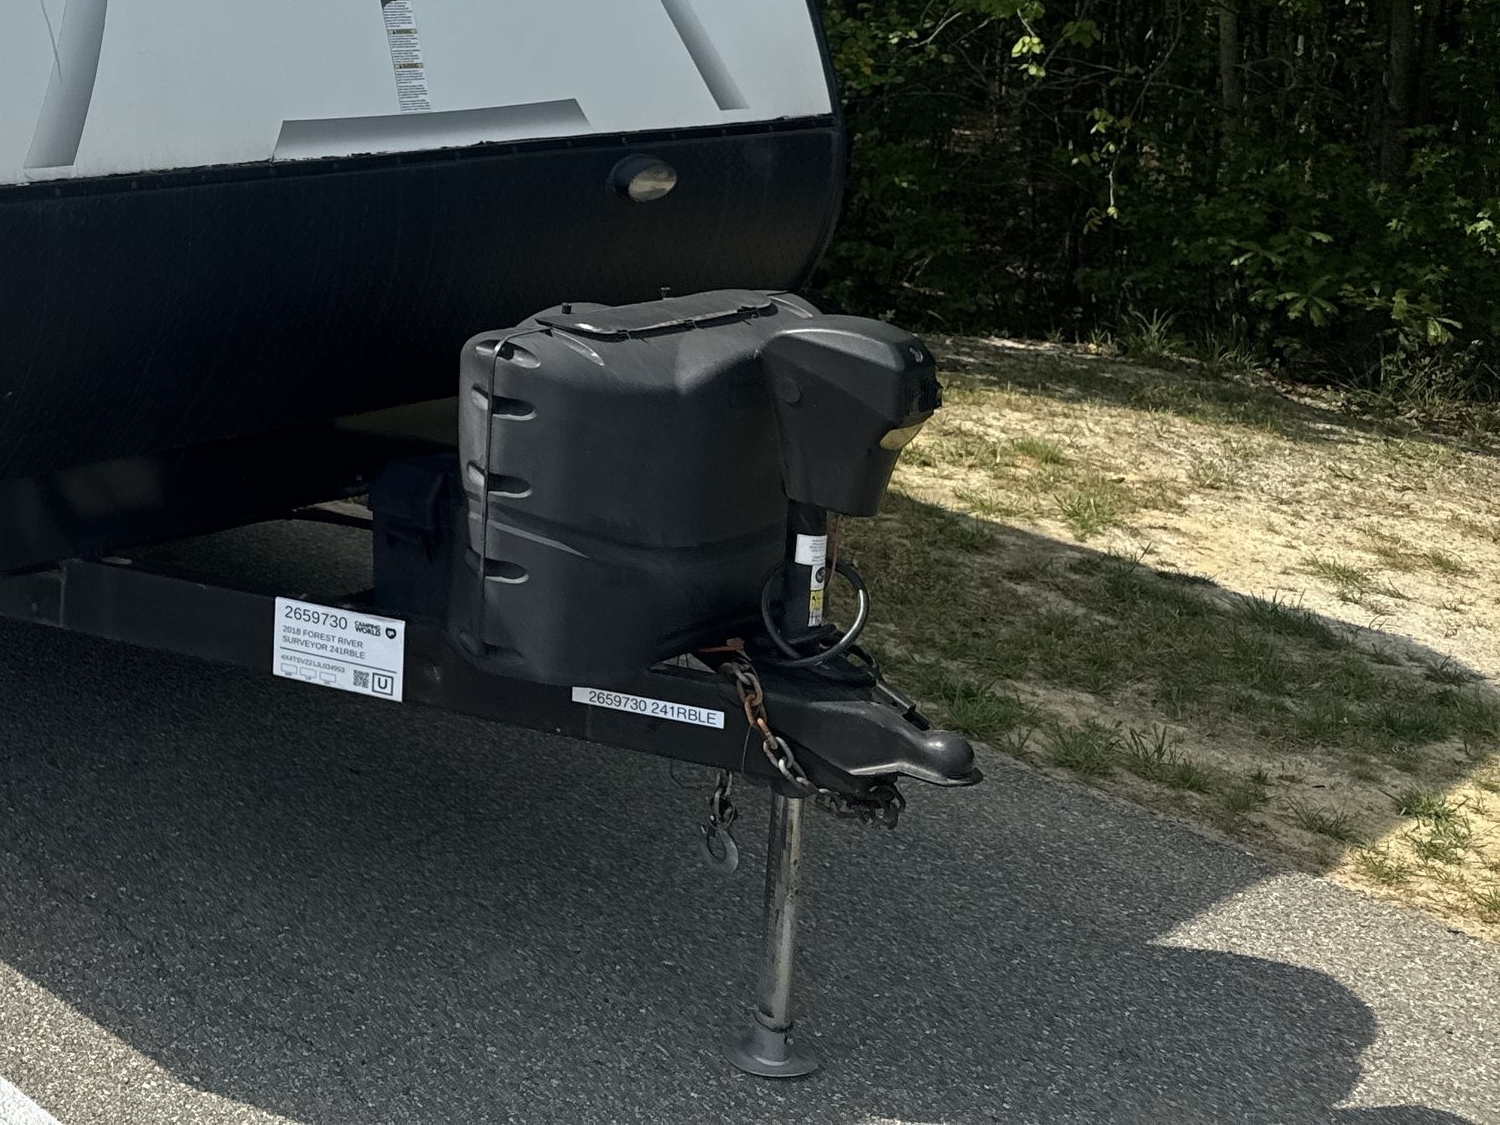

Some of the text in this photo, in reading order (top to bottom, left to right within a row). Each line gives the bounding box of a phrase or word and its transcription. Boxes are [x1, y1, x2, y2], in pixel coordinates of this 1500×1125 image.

[284, 605, 348, 630] 2659730
[282, 625, 363, 649] 2018 FOREST RIVER
[355, 625, 381, 637] WORLD
[282, 635, 366, 659] SURVEYOR 241RBLE
[377, 677, 388, 690] U
[588, 690, 717, 725] 2659730 241RBLE
